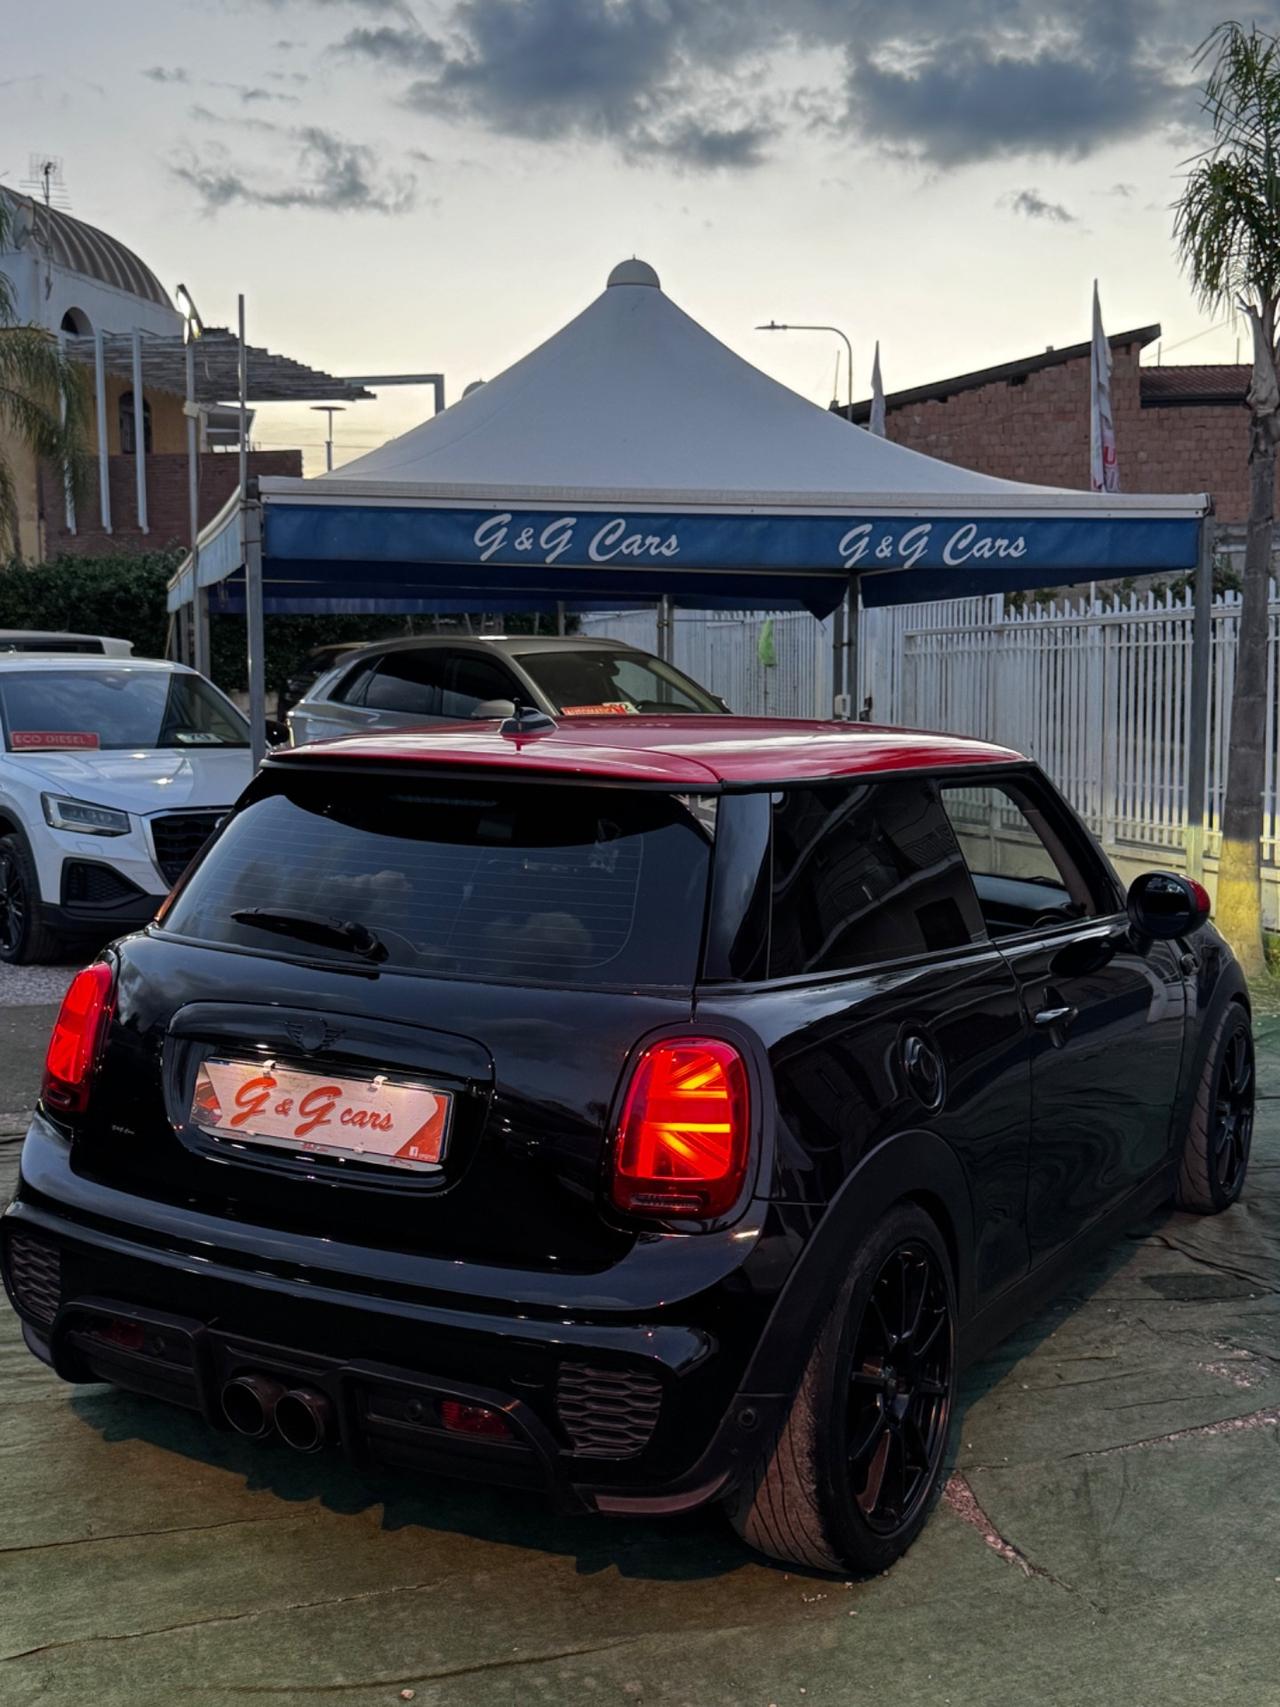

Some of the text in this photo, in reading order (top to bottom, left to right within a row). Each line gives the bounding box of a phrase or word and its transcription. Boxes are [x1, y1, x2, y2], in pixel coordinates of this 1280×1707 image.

[588, 518, 680, 562] Cars
[942, 523, 1028, 566] Cars
[15, 734, 86, 745] ECO DIESEL
[340, 1108, 394, 1132] cars
